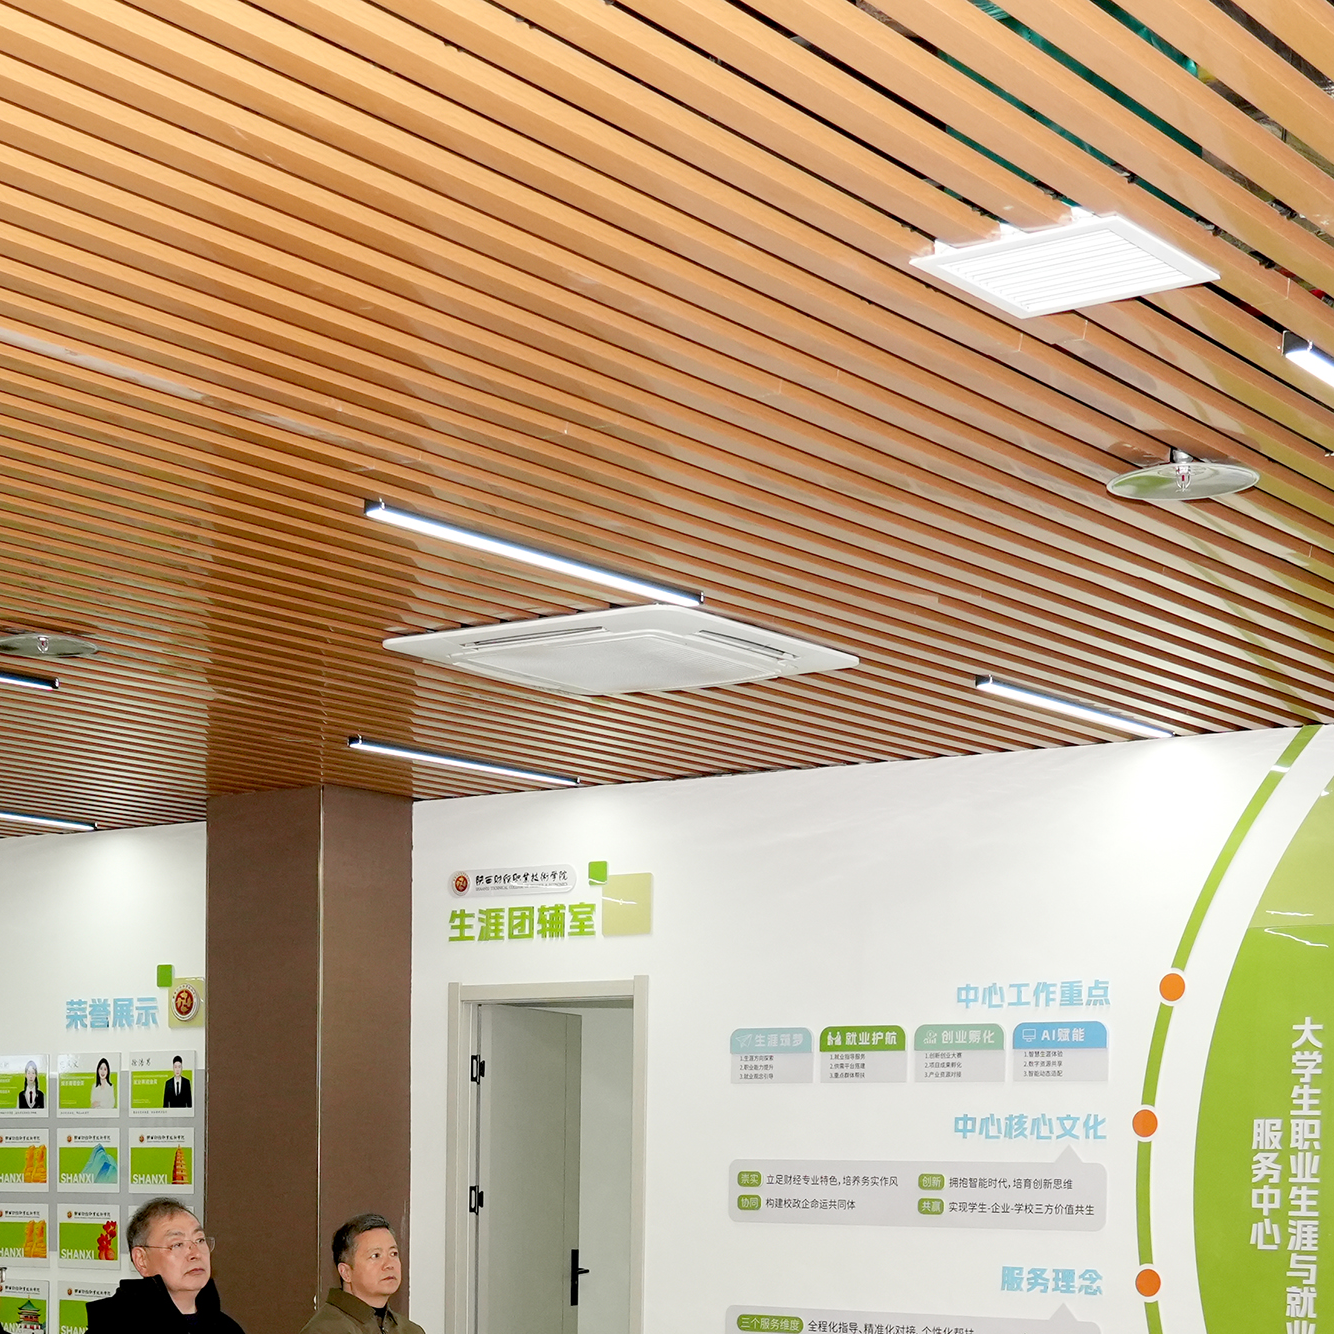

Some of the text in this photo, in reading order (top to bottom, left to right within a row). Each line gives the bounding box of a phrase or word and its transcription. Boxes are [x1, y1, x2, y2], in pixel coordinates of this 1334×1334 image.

[449, 902, 596, 942] 生涯团辅室
[957, 980, 1111, 1009] 中心工作重点
[65, 996, 159, 1029] 荣誉展示
[754, 1033, 804, 1047] 生涯筑梦
[845, 1031, 898, 1045] 就业护航
[941, 1030, 995, 1044] 创业孵化
[1041, 1028, 1085, 1042] AI赋能
[954, 1113, 1107, 1140] 中心核心文化
[60, 1173, 95, 1183] SHANXI
[132, 1174, 167, 1184] SHANXI
[740, 1173, 759, 1185] 崇实
[766, 1174, 899, 1187] 立足财经专业特色，培养务实作风
[922, 1176, 941, 1187] 创新
[949, 1177, 1073, 1190] 拥抱智能时代，培育创新思维
[1249, 1118, 1283, 1251] 服务中心
[740, 1197, 759, 1208] 协同
[765, 1198, 856, 1210] 构建校政企命运共同体
[922, 1201, 941, 1212] 共赢
[949, 1201, 1095, 1216] 实现学生-企业-学校三方价值共生
[60, 1248, 95, 1260] SHANXI
[1000, 1265, 1103, 1296] 服务理念
[740, 1316, 800, 1332] 三个服务维度
